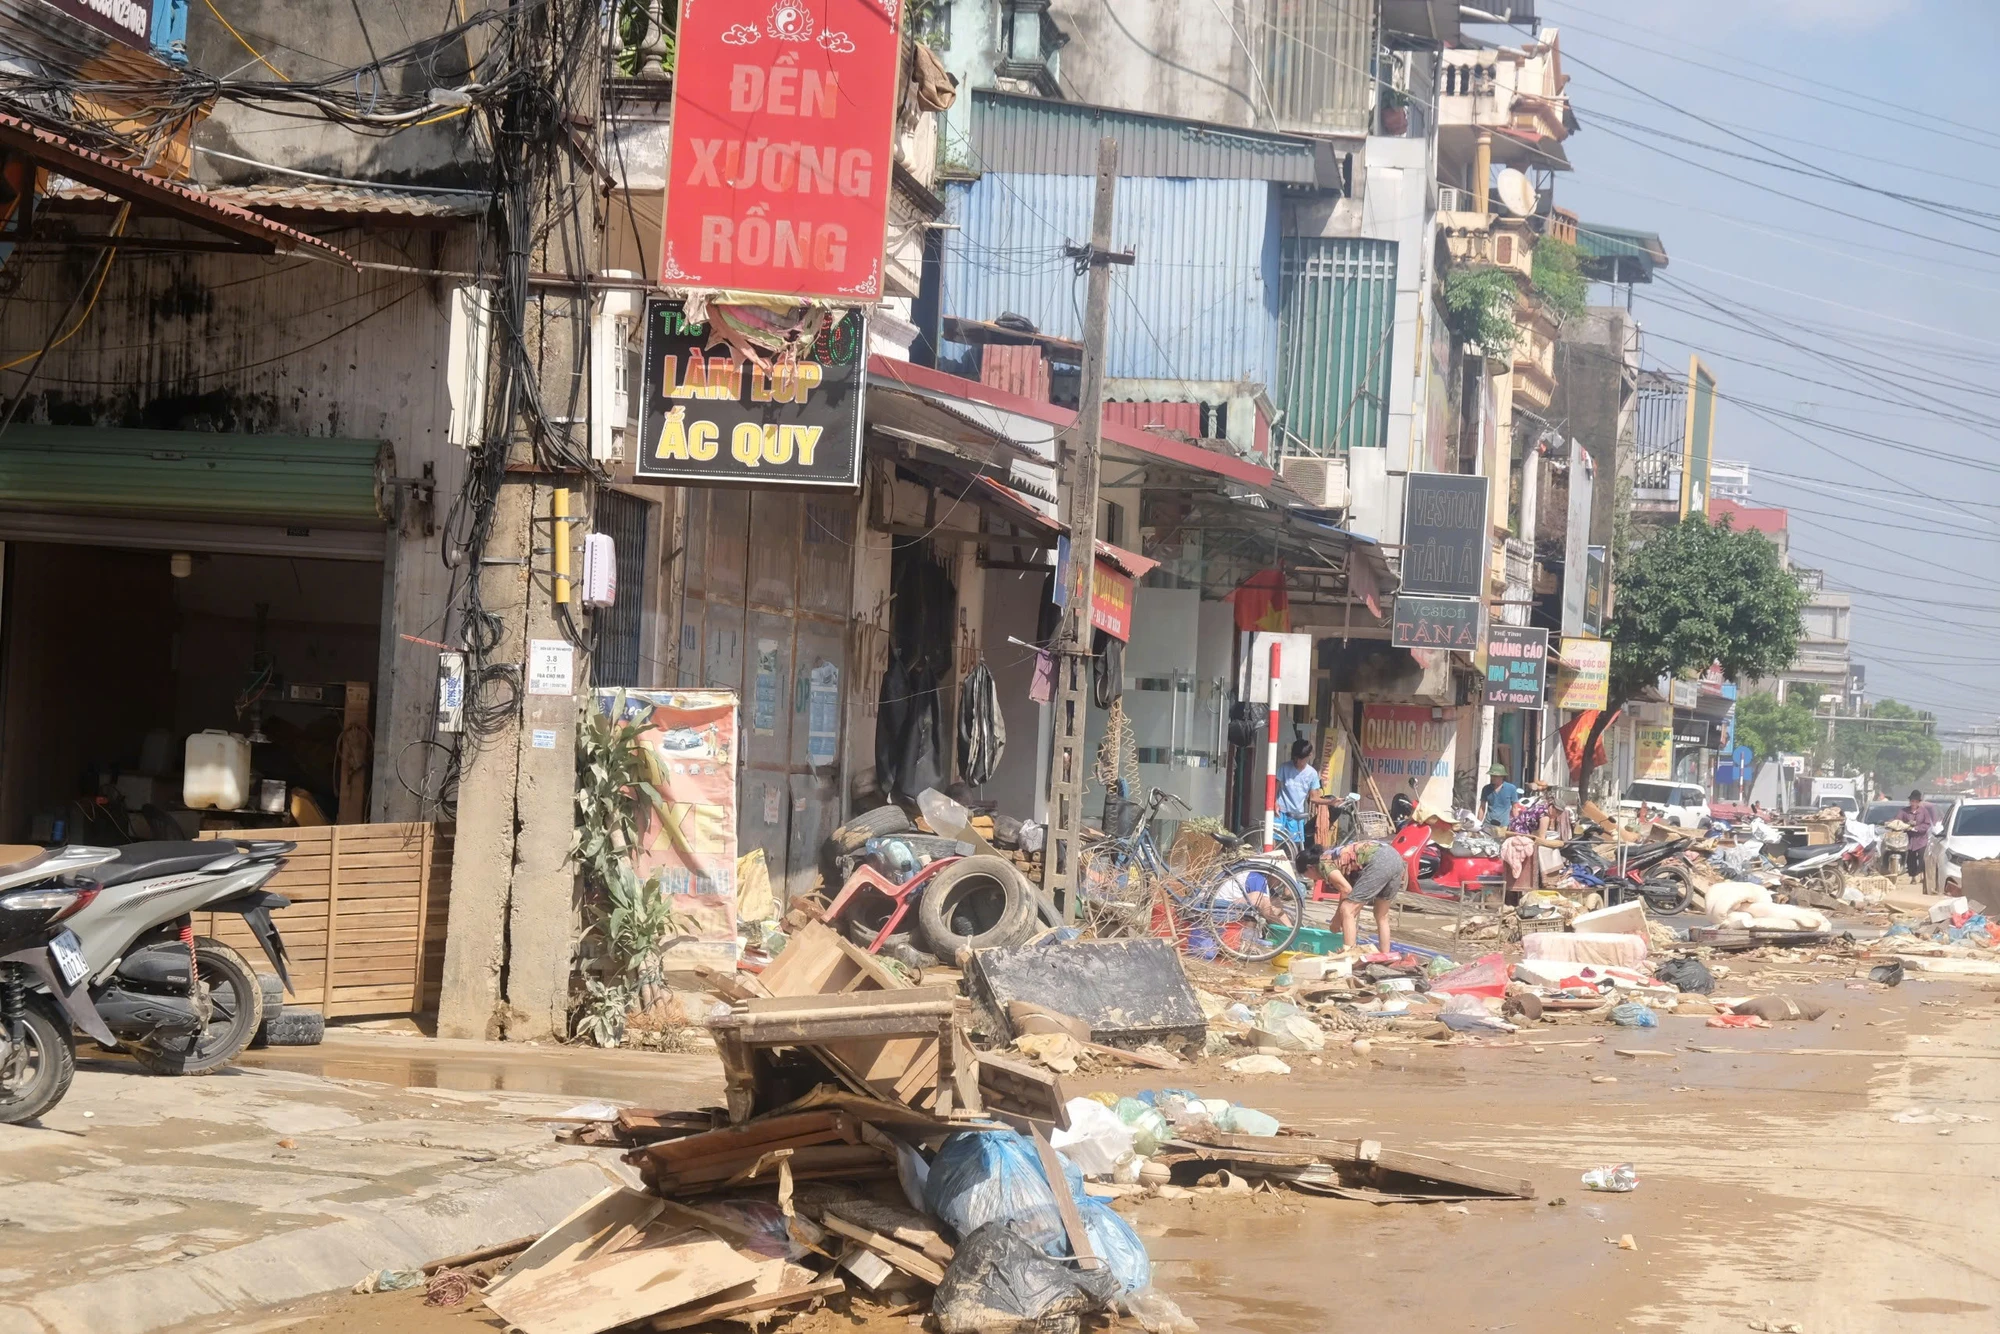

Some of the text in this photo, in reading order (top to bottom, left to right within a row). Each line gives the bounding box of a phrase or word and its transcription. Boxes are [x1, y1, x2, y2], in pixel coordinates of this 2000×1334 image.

[729, 50, 839, 119] ĐỀN
[686, 136, 873, 198] XƯƠNG
[699, 200, 849, 273] RỒNG
[662, 347, 744, 401] LÀM
[655, 405, 824, 467] ẮC QUY
[1414, 488, 1481, 530] VESTON
[1411, 537, 1454, 584] TÂN
[1409, 600, 1467, 620] Veston
[1397, 618, 1476, 645] TÂN Á
[1489, 638, 1544, 659] QUẢNG CÁO
[546, 655, 557, 663] 3.8
[1488, 661, 1537, 682] IN BẠT
[1489, 689, 1536, 704] LẤY NGAY
[1509, 678, 1539, 692] DECAL
[1366, 708, 1417, 751] QUẢNG
[1377, 758, 1404, 775] PHUN
[1407, 754, 1427, 777] KHỔ
[650, 801, 726, 854] XE
